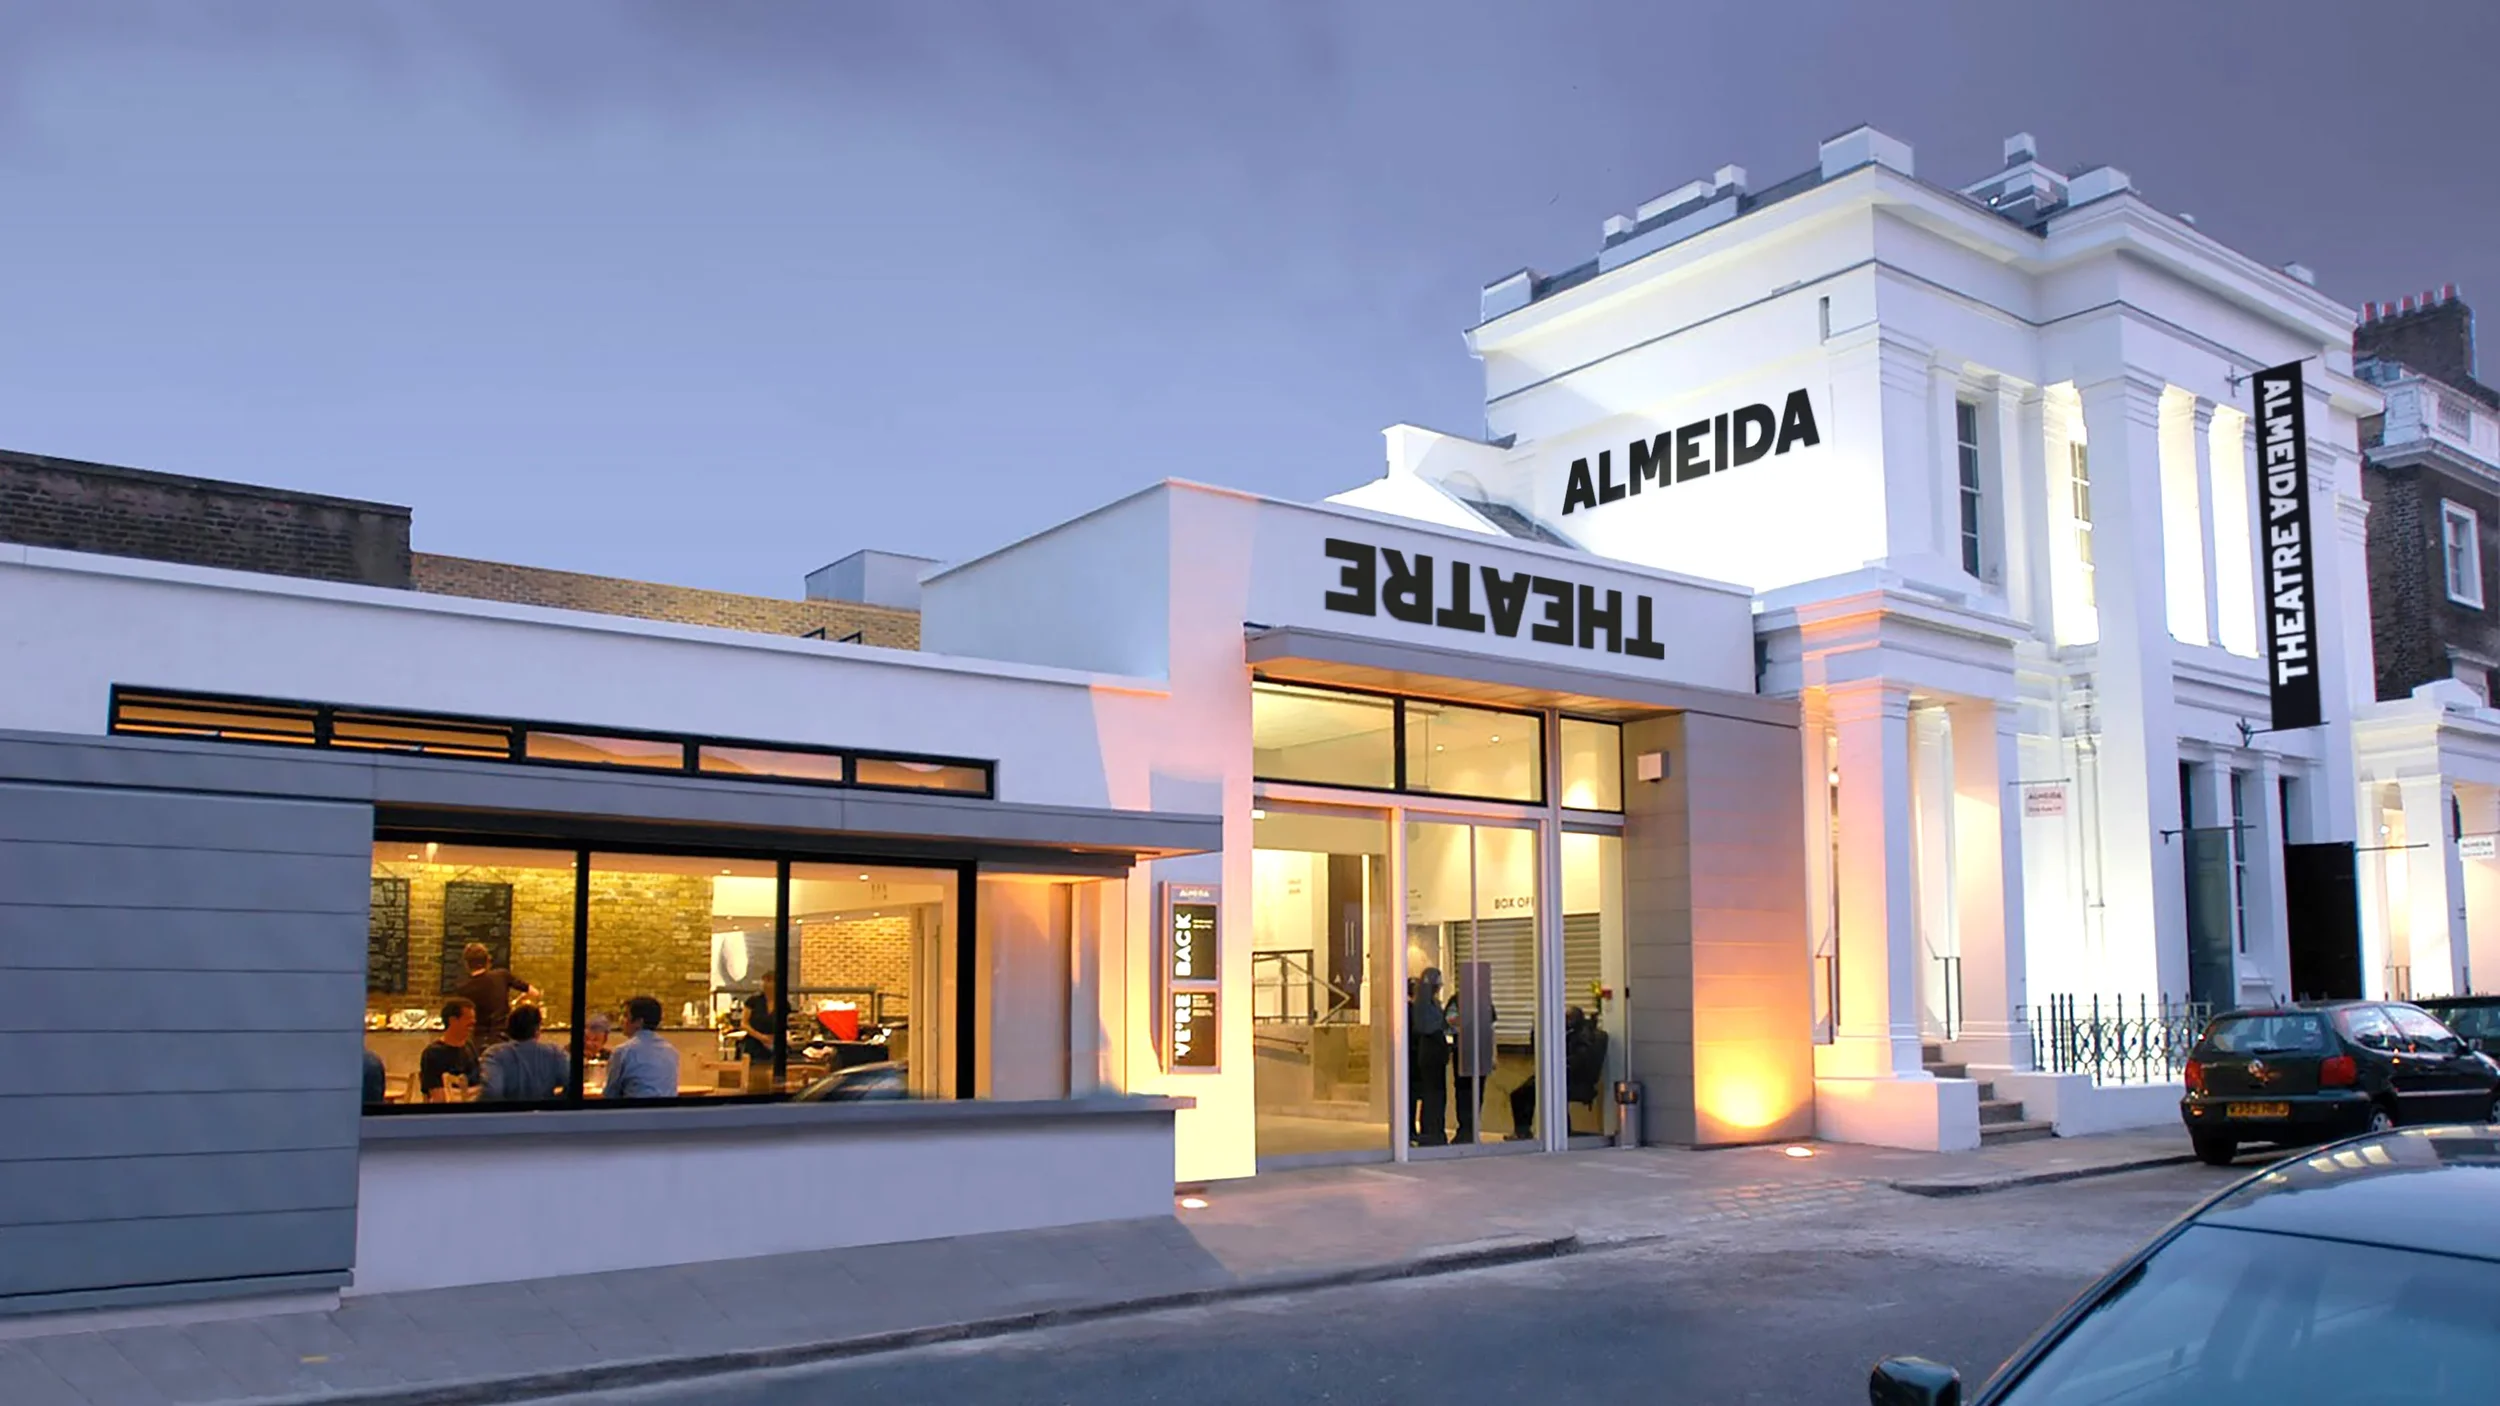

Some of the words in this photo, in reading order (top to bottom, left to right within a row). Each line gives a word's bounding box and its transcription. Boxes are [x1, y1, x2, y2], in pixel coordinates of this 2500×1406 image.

[1561, 387, 1821, 516] ALMEIDA
[2263, 379, 2299, 521] ALMEIDA
[1324, 537, 1667, 661] THEATRE
[2270, 521, 2309, 687] THEATRE
[1175, 913, 1192, 976] BACK
[1494, 897, 1515, 910] BOX
